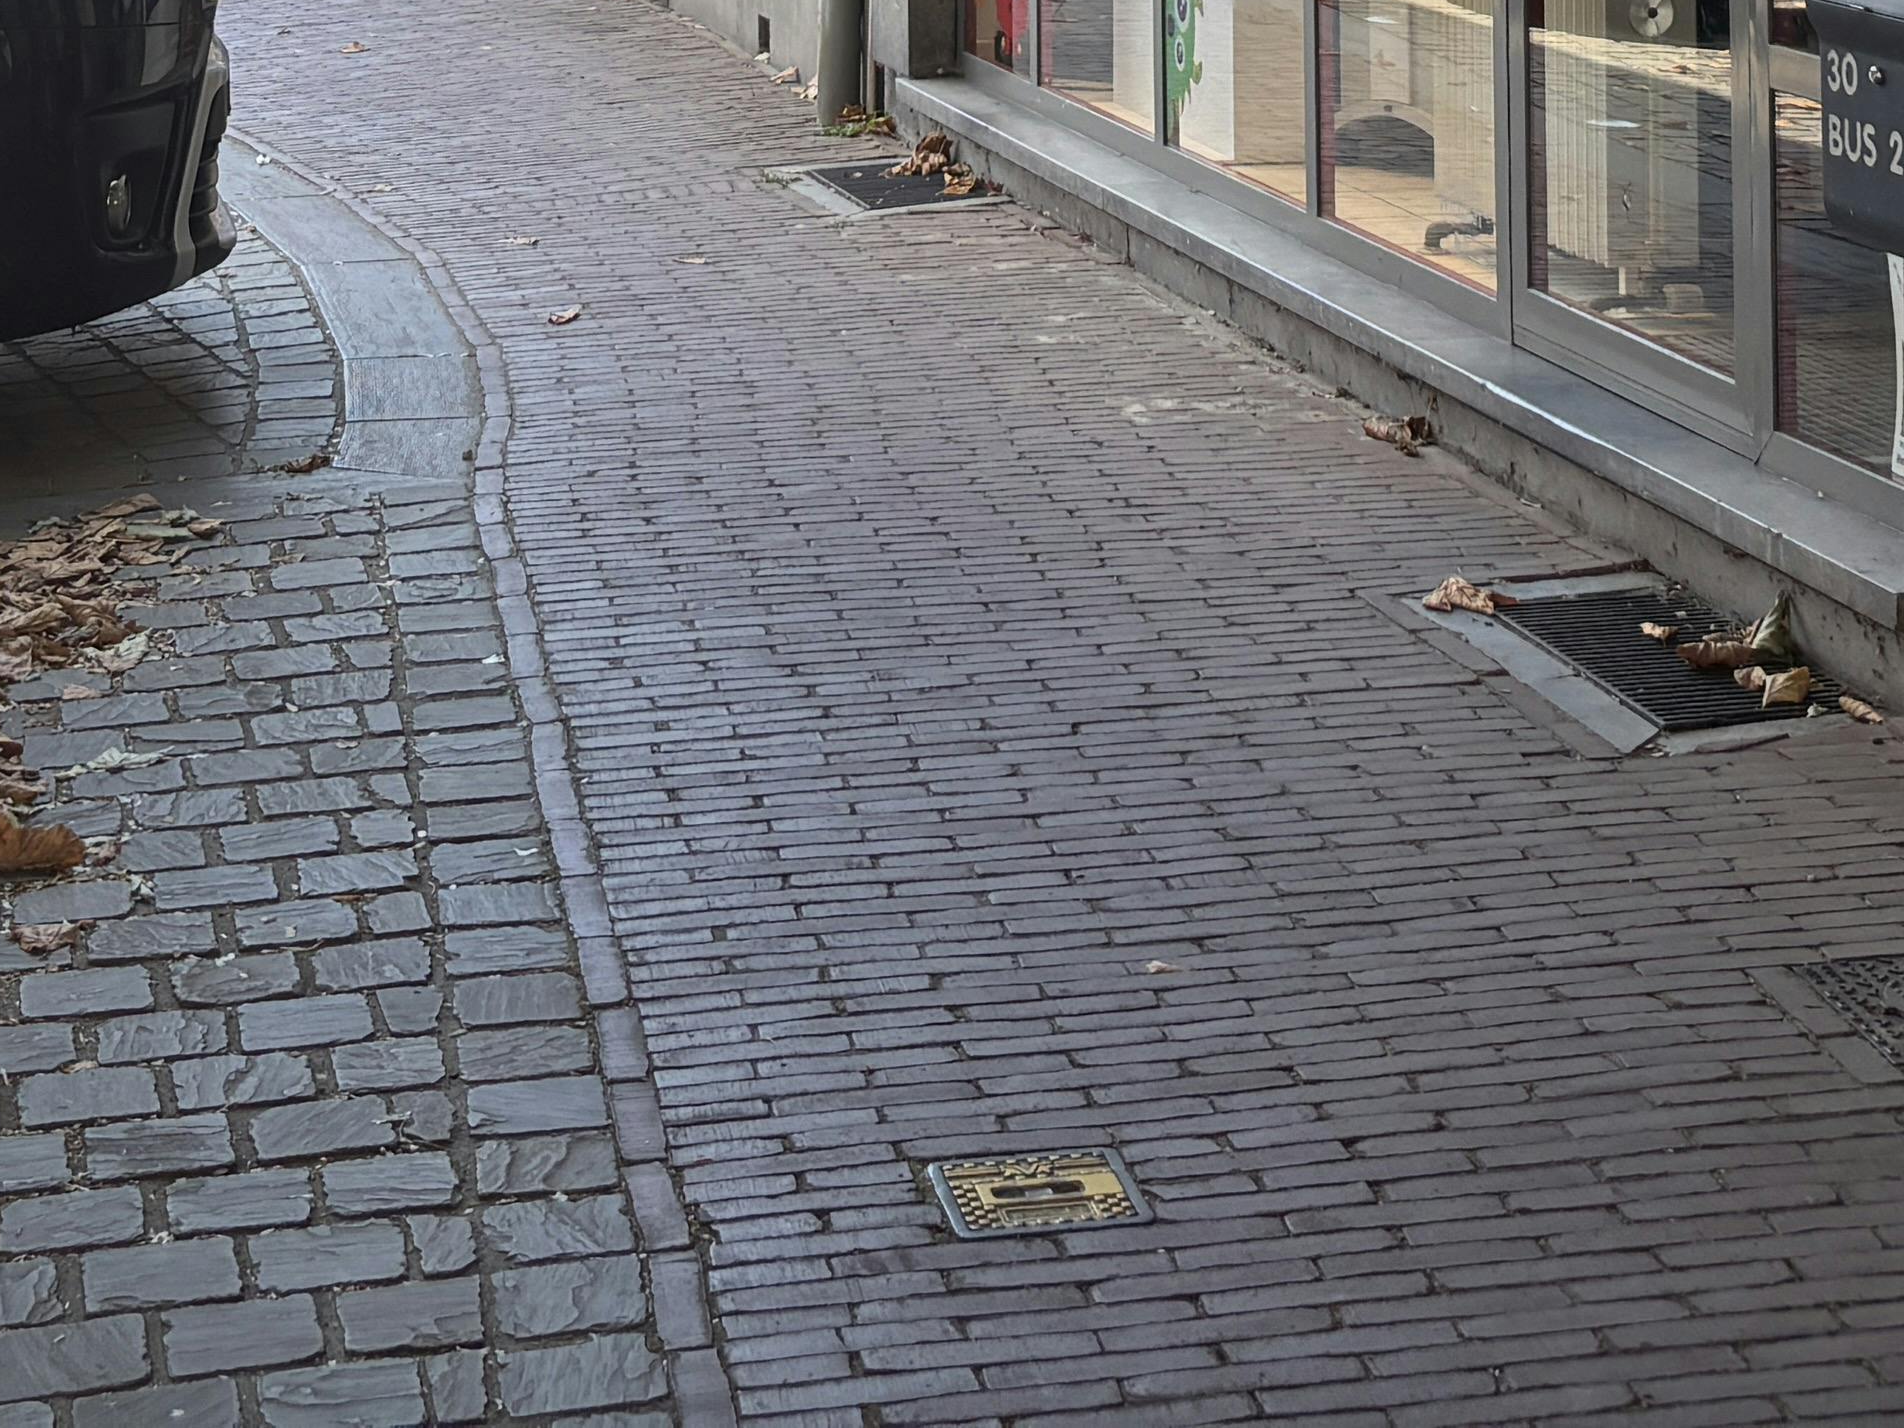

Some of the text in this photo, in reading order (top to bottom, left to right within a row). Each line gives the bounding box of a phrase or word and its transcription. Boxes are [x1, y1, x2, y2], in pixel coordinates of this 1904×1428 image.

[1827, 49, 1858, 95] 30
[1828, 113, 1904, 176] BUS 2
